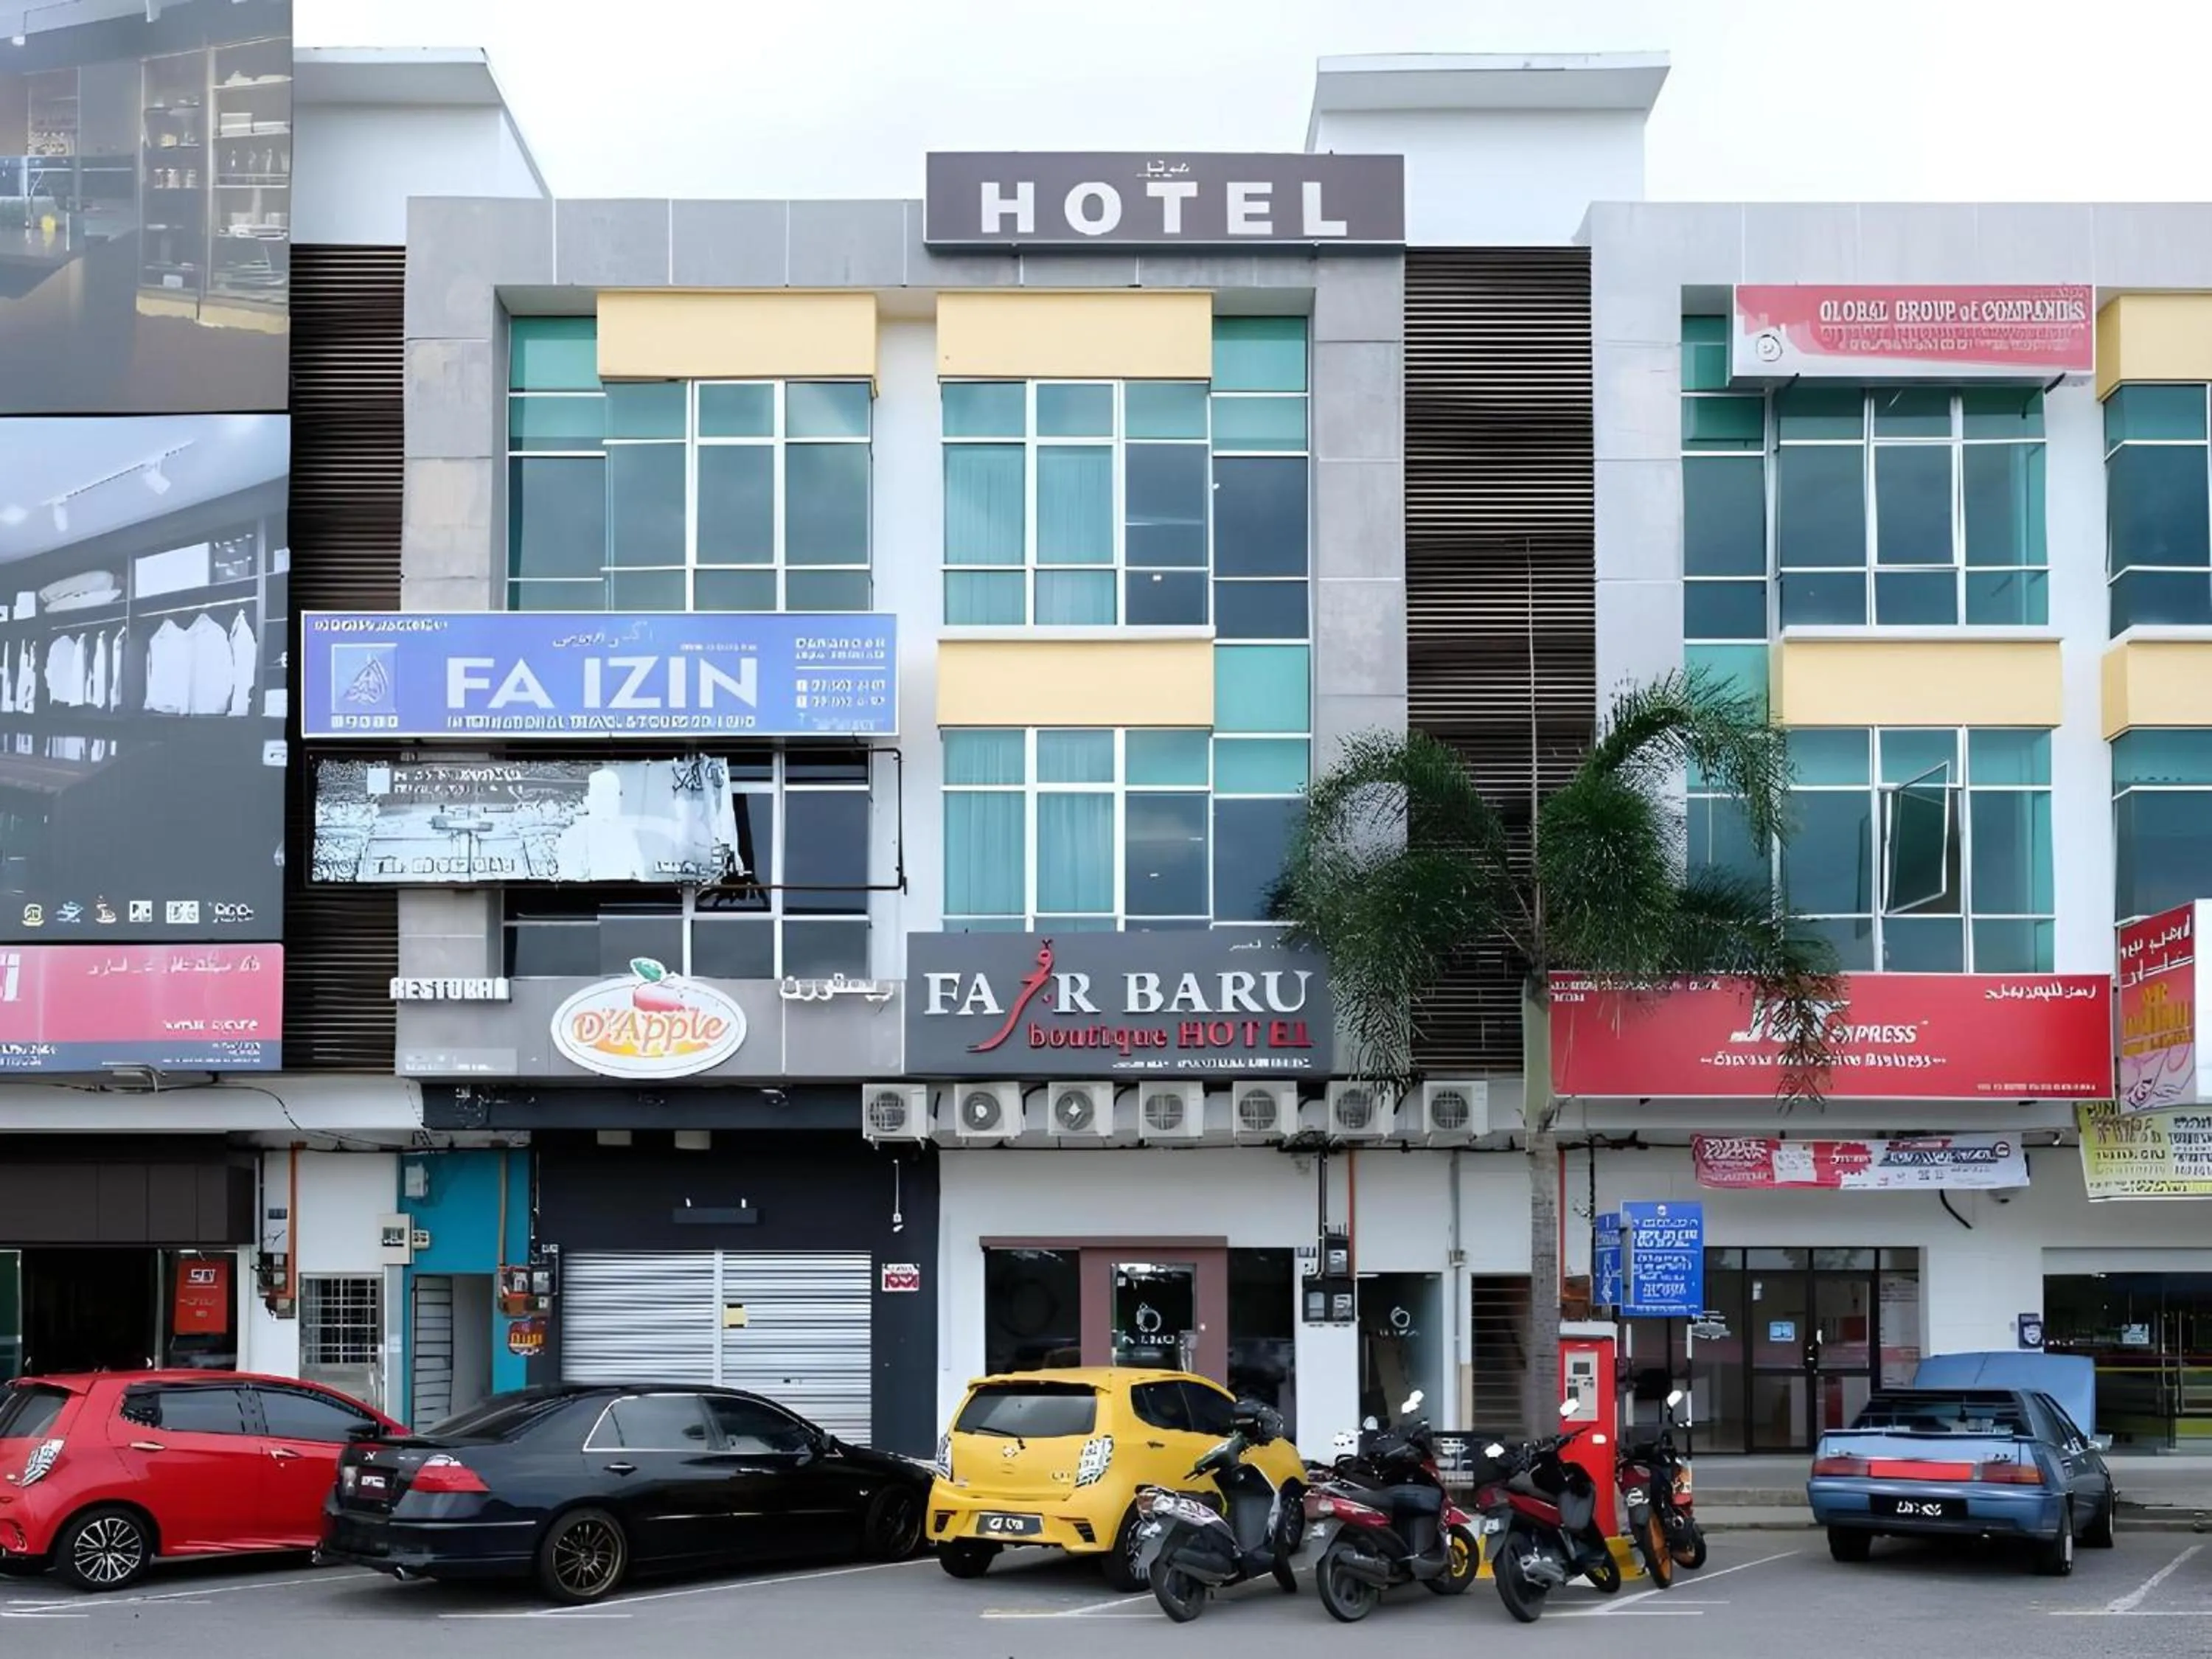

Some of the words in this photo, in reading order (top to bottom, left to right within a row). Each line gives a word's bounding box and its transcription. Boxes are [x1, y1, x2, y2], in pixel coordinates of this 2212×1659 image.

[981, 181, 1347, 236] HOTEL
[1122, 970, 1315, 1015] BARU
[1029, 1020, 1167, 1056] boutique
[1177, 1020, 1315, 1048] HOTEL
